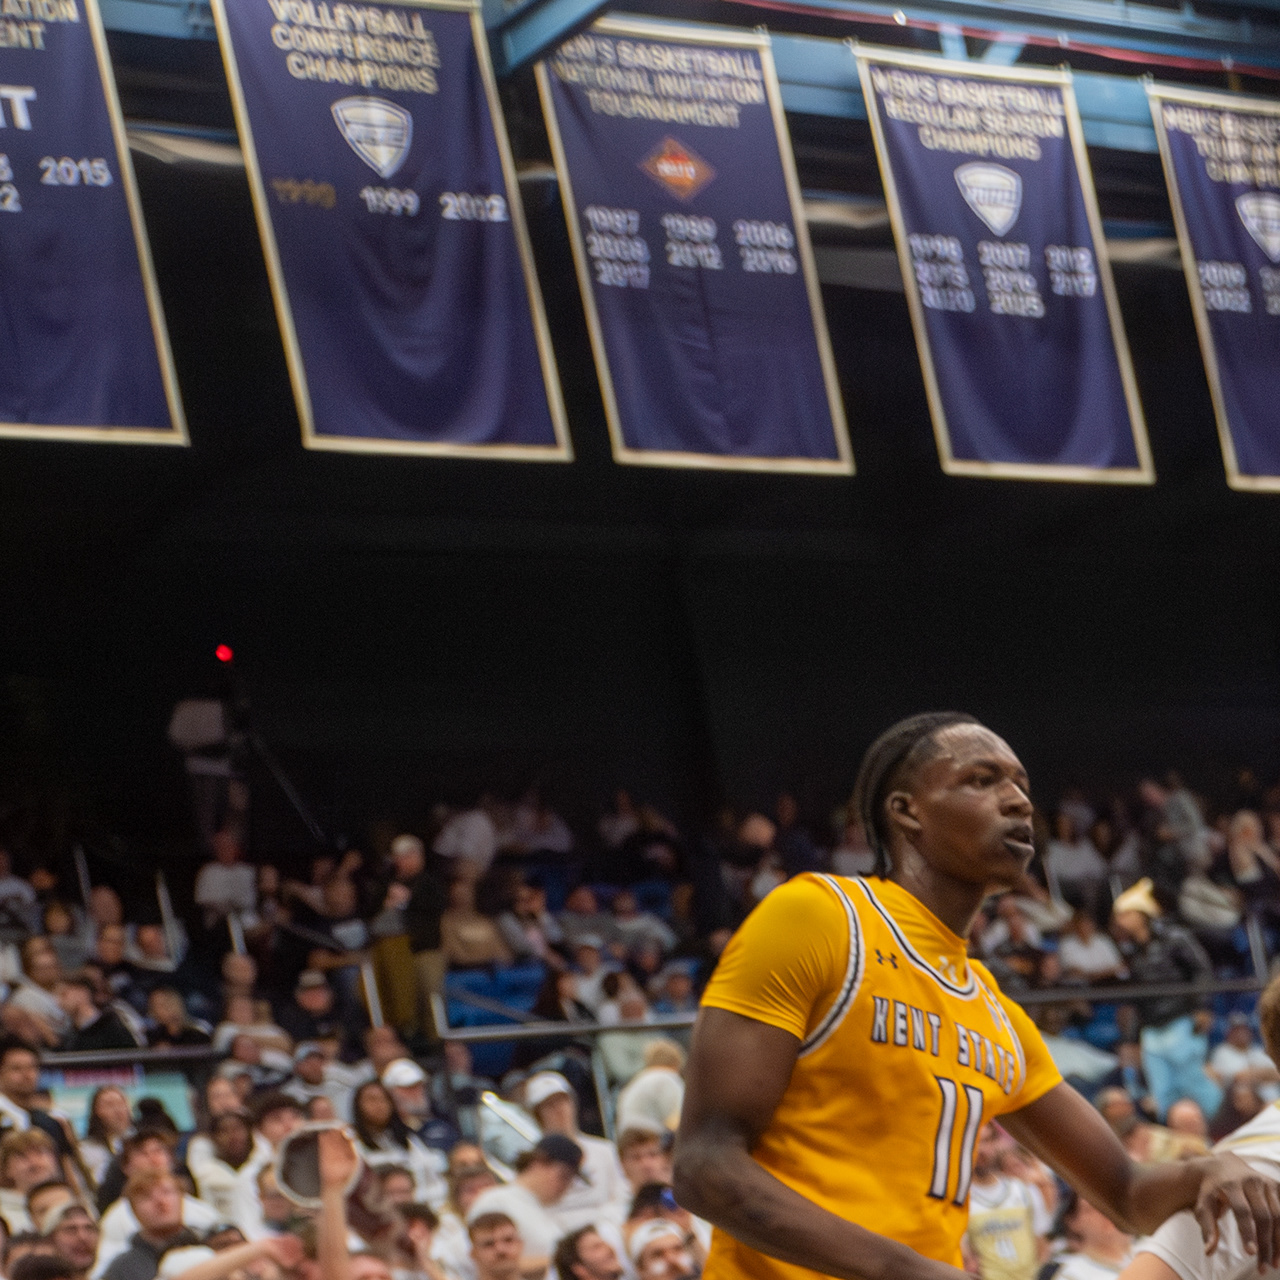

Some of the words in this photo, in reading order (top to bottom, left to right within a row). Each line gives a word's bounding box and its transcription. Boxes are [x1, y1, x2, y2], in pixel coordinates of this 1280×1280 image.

[271, 22, 441, 70] CONFERENCE
[286, 51, 440, 95] CHAMPIONS
[918, 125, 1042, 162] CHAMPIONS
[871, 994, 942, 1057] KENT
[953, 1021, 1016, 1096] STATE
[926, 1073, 984, 1209] 11
